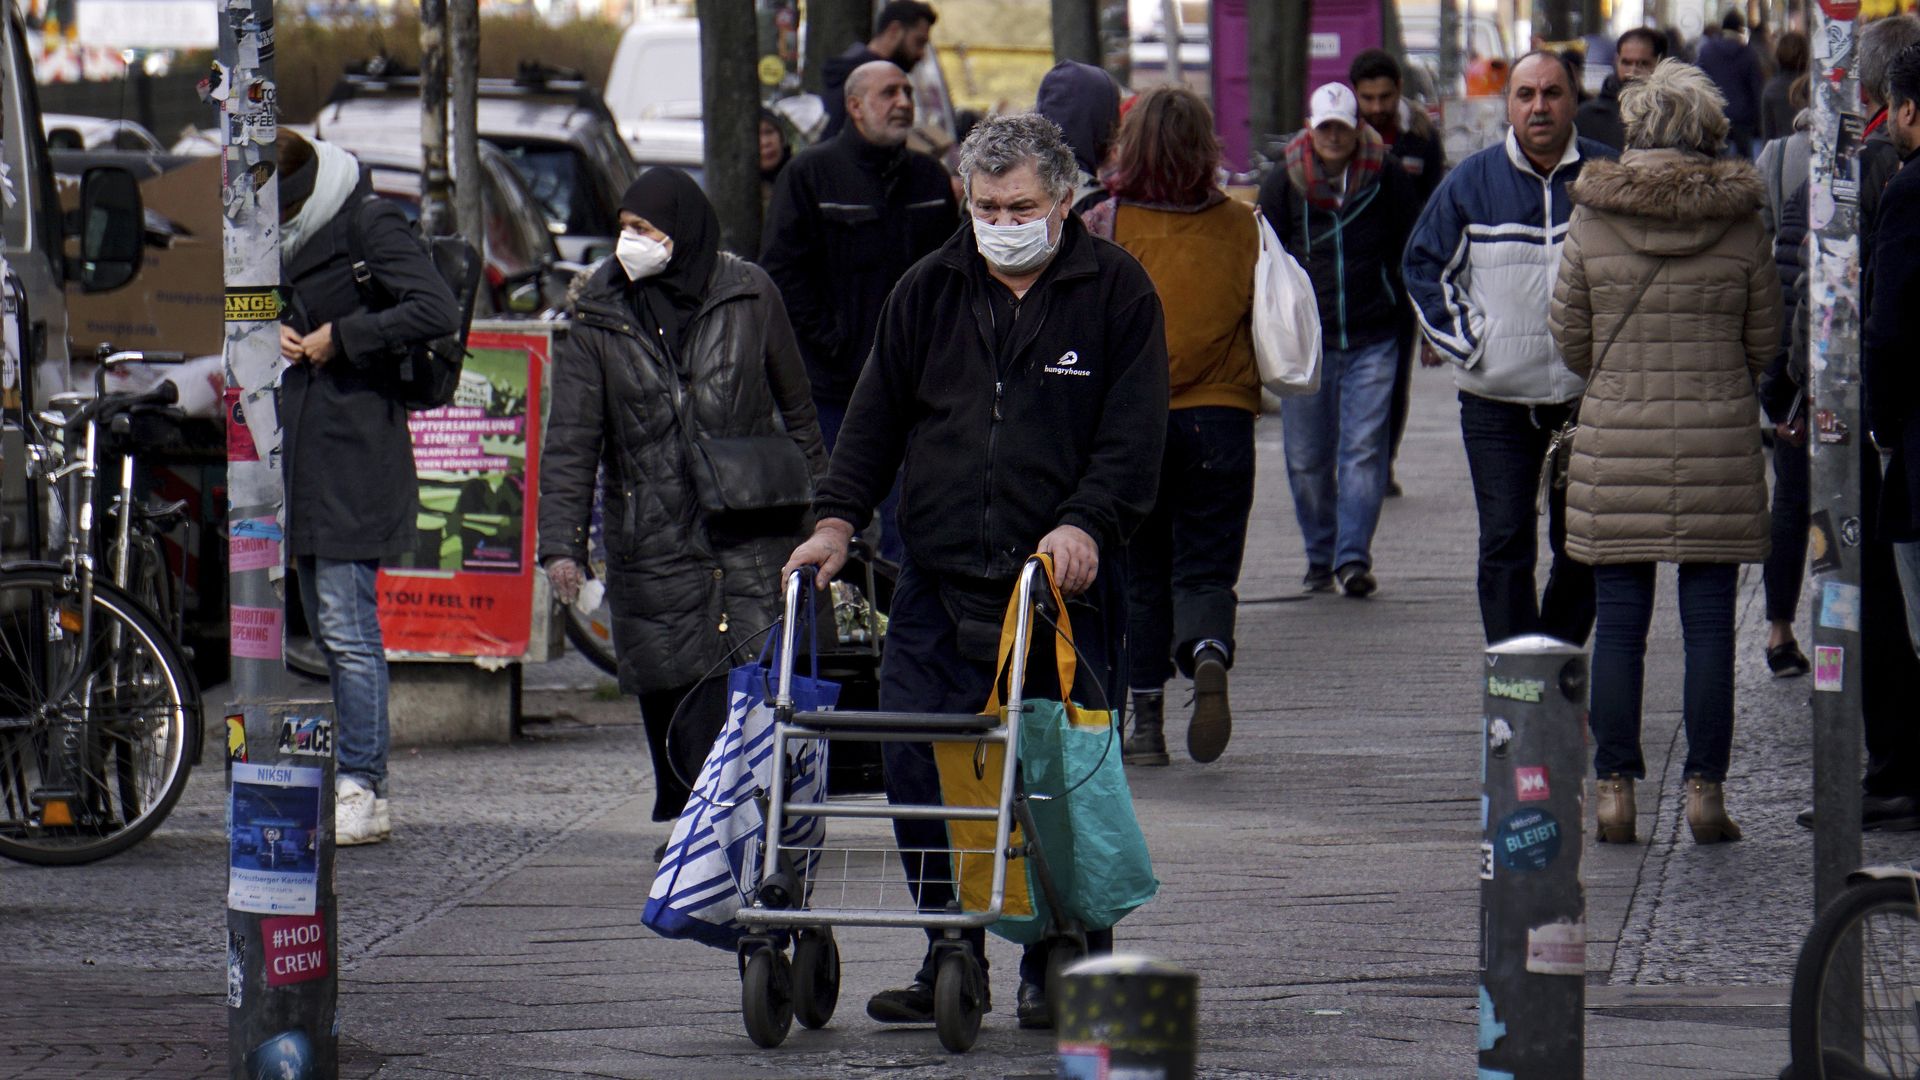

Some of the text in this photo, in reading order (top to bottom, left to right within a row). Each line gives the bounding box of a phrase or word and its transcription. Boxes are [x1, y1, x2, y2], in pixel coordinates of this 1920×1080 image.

[1044, 365, 1091, 376] hungryhouse
[423, 432, 471, 444] STÖREN!
[385, 591, 496, 609] YOU FEEL IT?
[232, 624, 269, 641] OPENING
[257, 768, 292, 782] NIKSN
[1505, 823, 1557, 853] BLEIBT
[272, 924, 320, 948] #HOD
[273, 950, 321, 975] CREW
